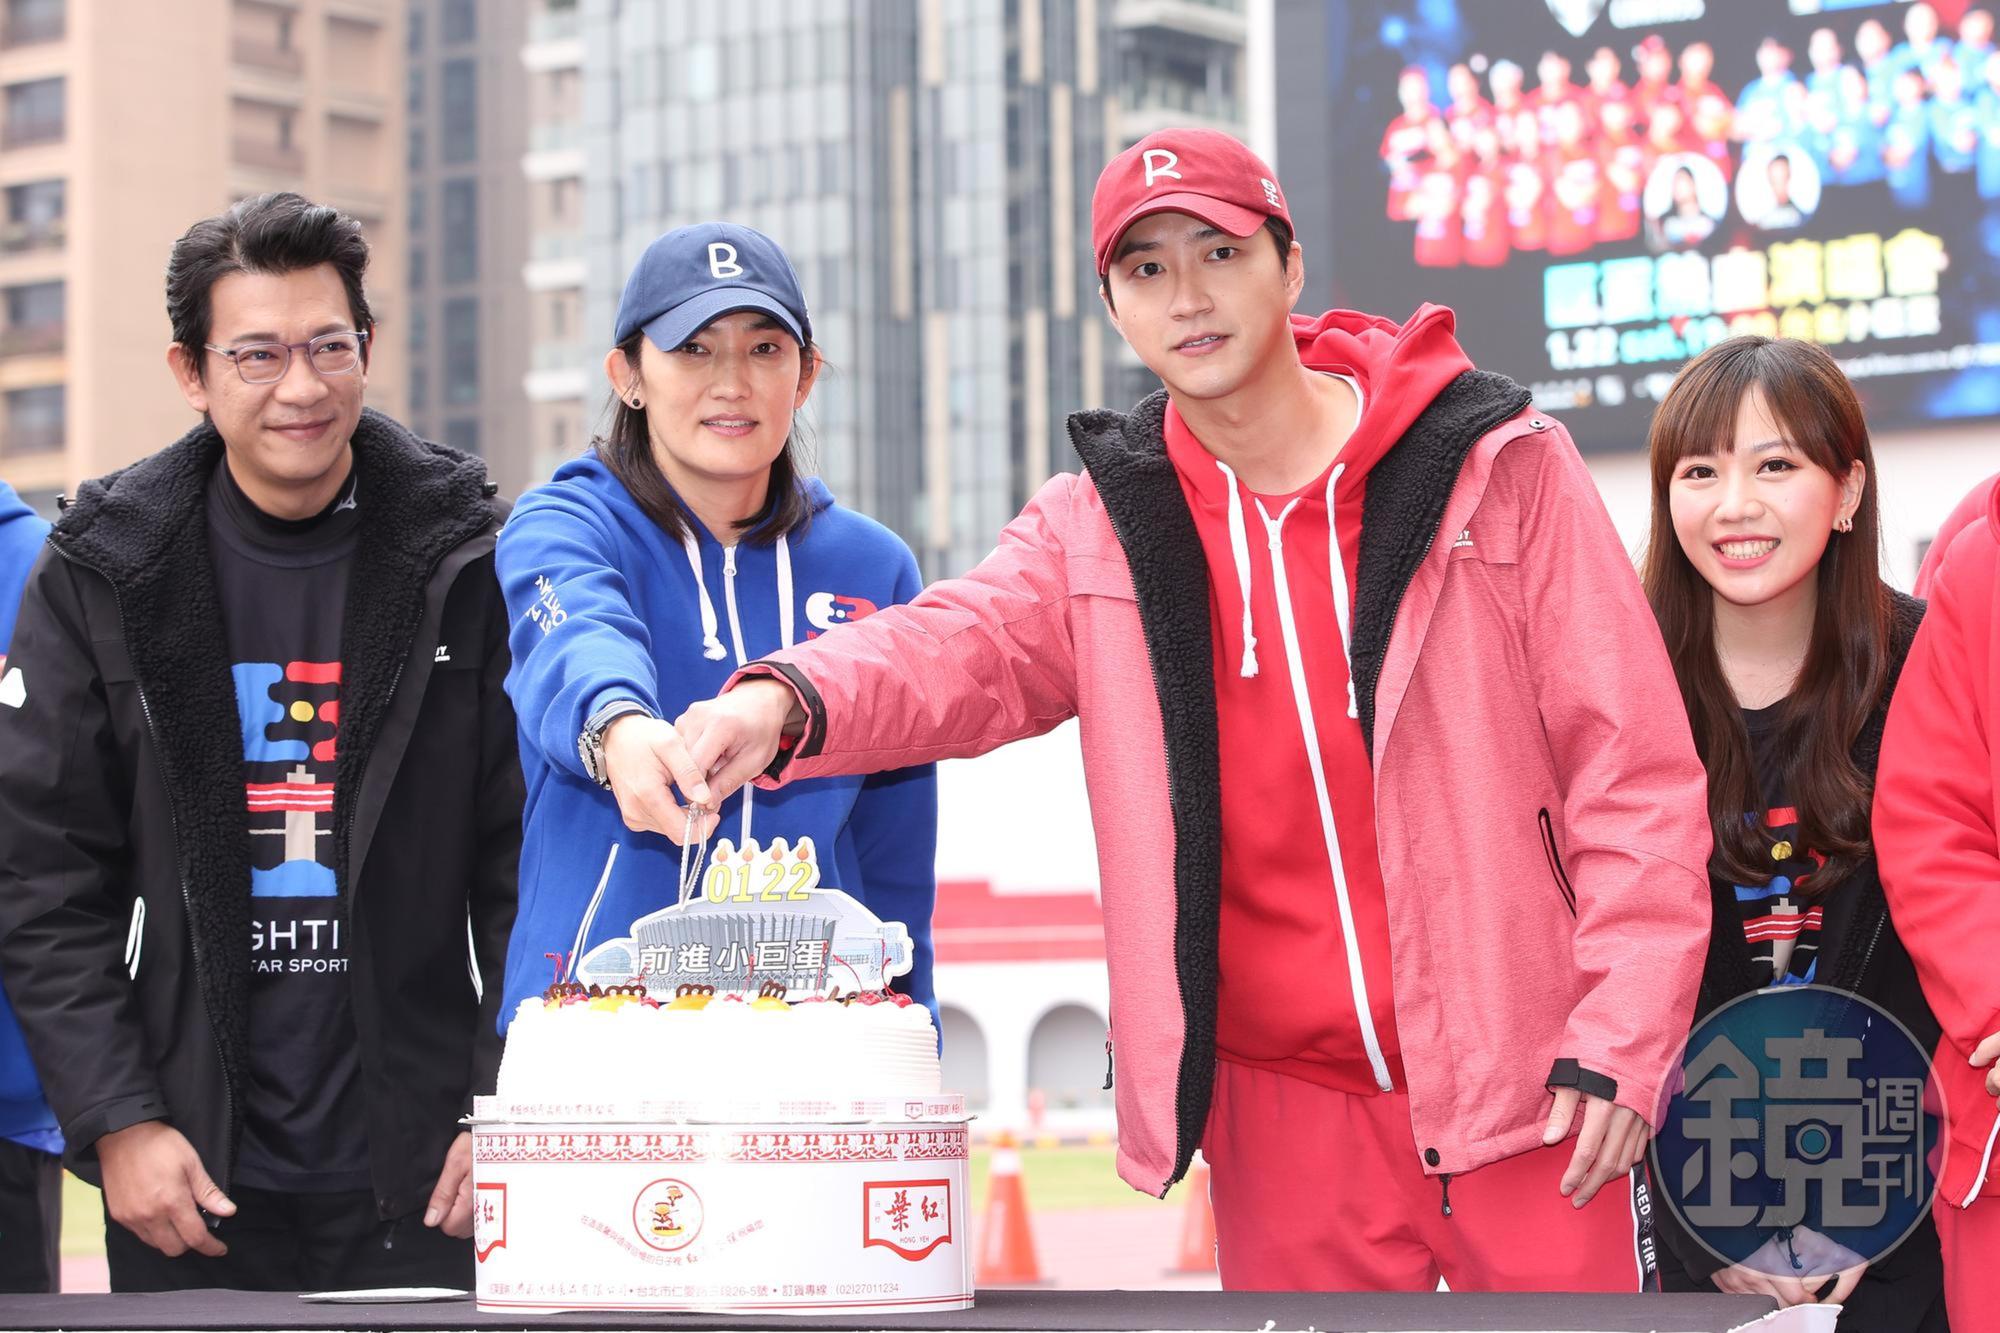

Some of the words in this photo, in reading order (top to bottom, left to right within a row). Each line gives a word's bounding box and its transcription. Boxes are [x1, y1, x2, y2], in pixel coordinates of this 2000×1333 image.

[1142, 148, 1183, 188] R
[707, 242, 744, 279] B
[706, 861, 813, 905] 0122
[288, 958, 349, 973] SPORT
[638, 939, 828, 977] 前進小巨蛋
[1635, 1183, 1652, 1217] RED
[1641, 1236, 1657, 1274] FIRE
